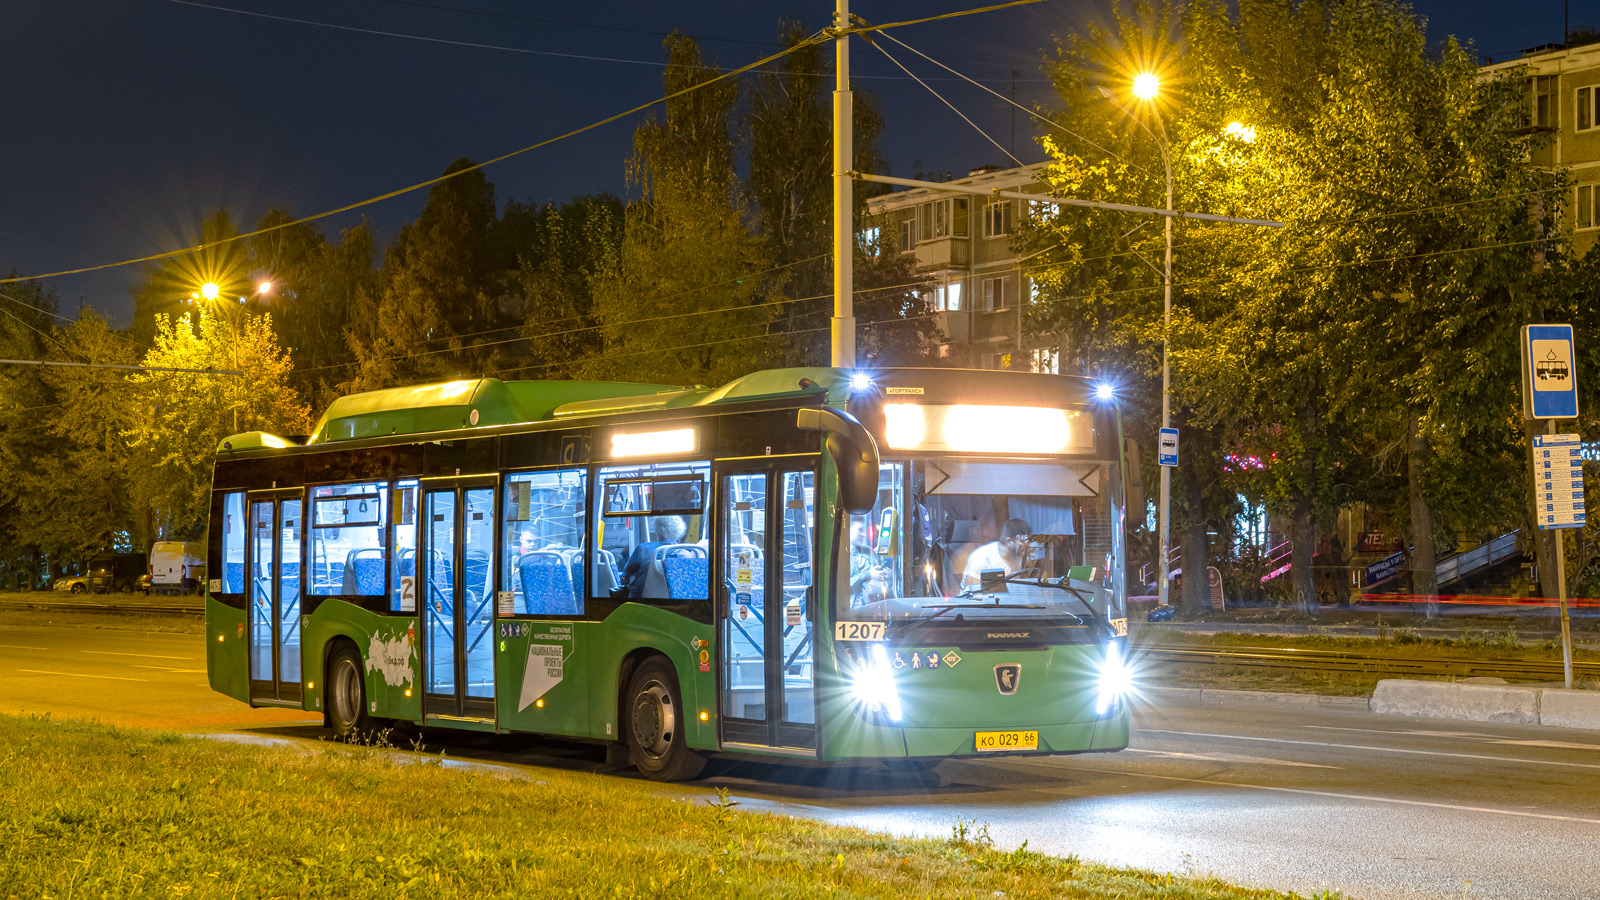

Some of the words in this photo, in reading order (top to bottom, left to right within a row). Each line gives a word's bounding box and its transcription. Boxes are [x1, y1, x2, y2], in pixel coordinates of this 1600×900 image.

[401, 578, 414, 600] 2
[838, 623, 881, 639] 1207
[531, 646, 562, 657] НАЦИОНАЛЬНЫЕ
[544, 657, 562, 667] ПРОЕКТЫ
[547, 667, 562, 678] РОССИИ
[999, 733, 1019, 746] 029
[1024, 732, 1035, 742] 66
